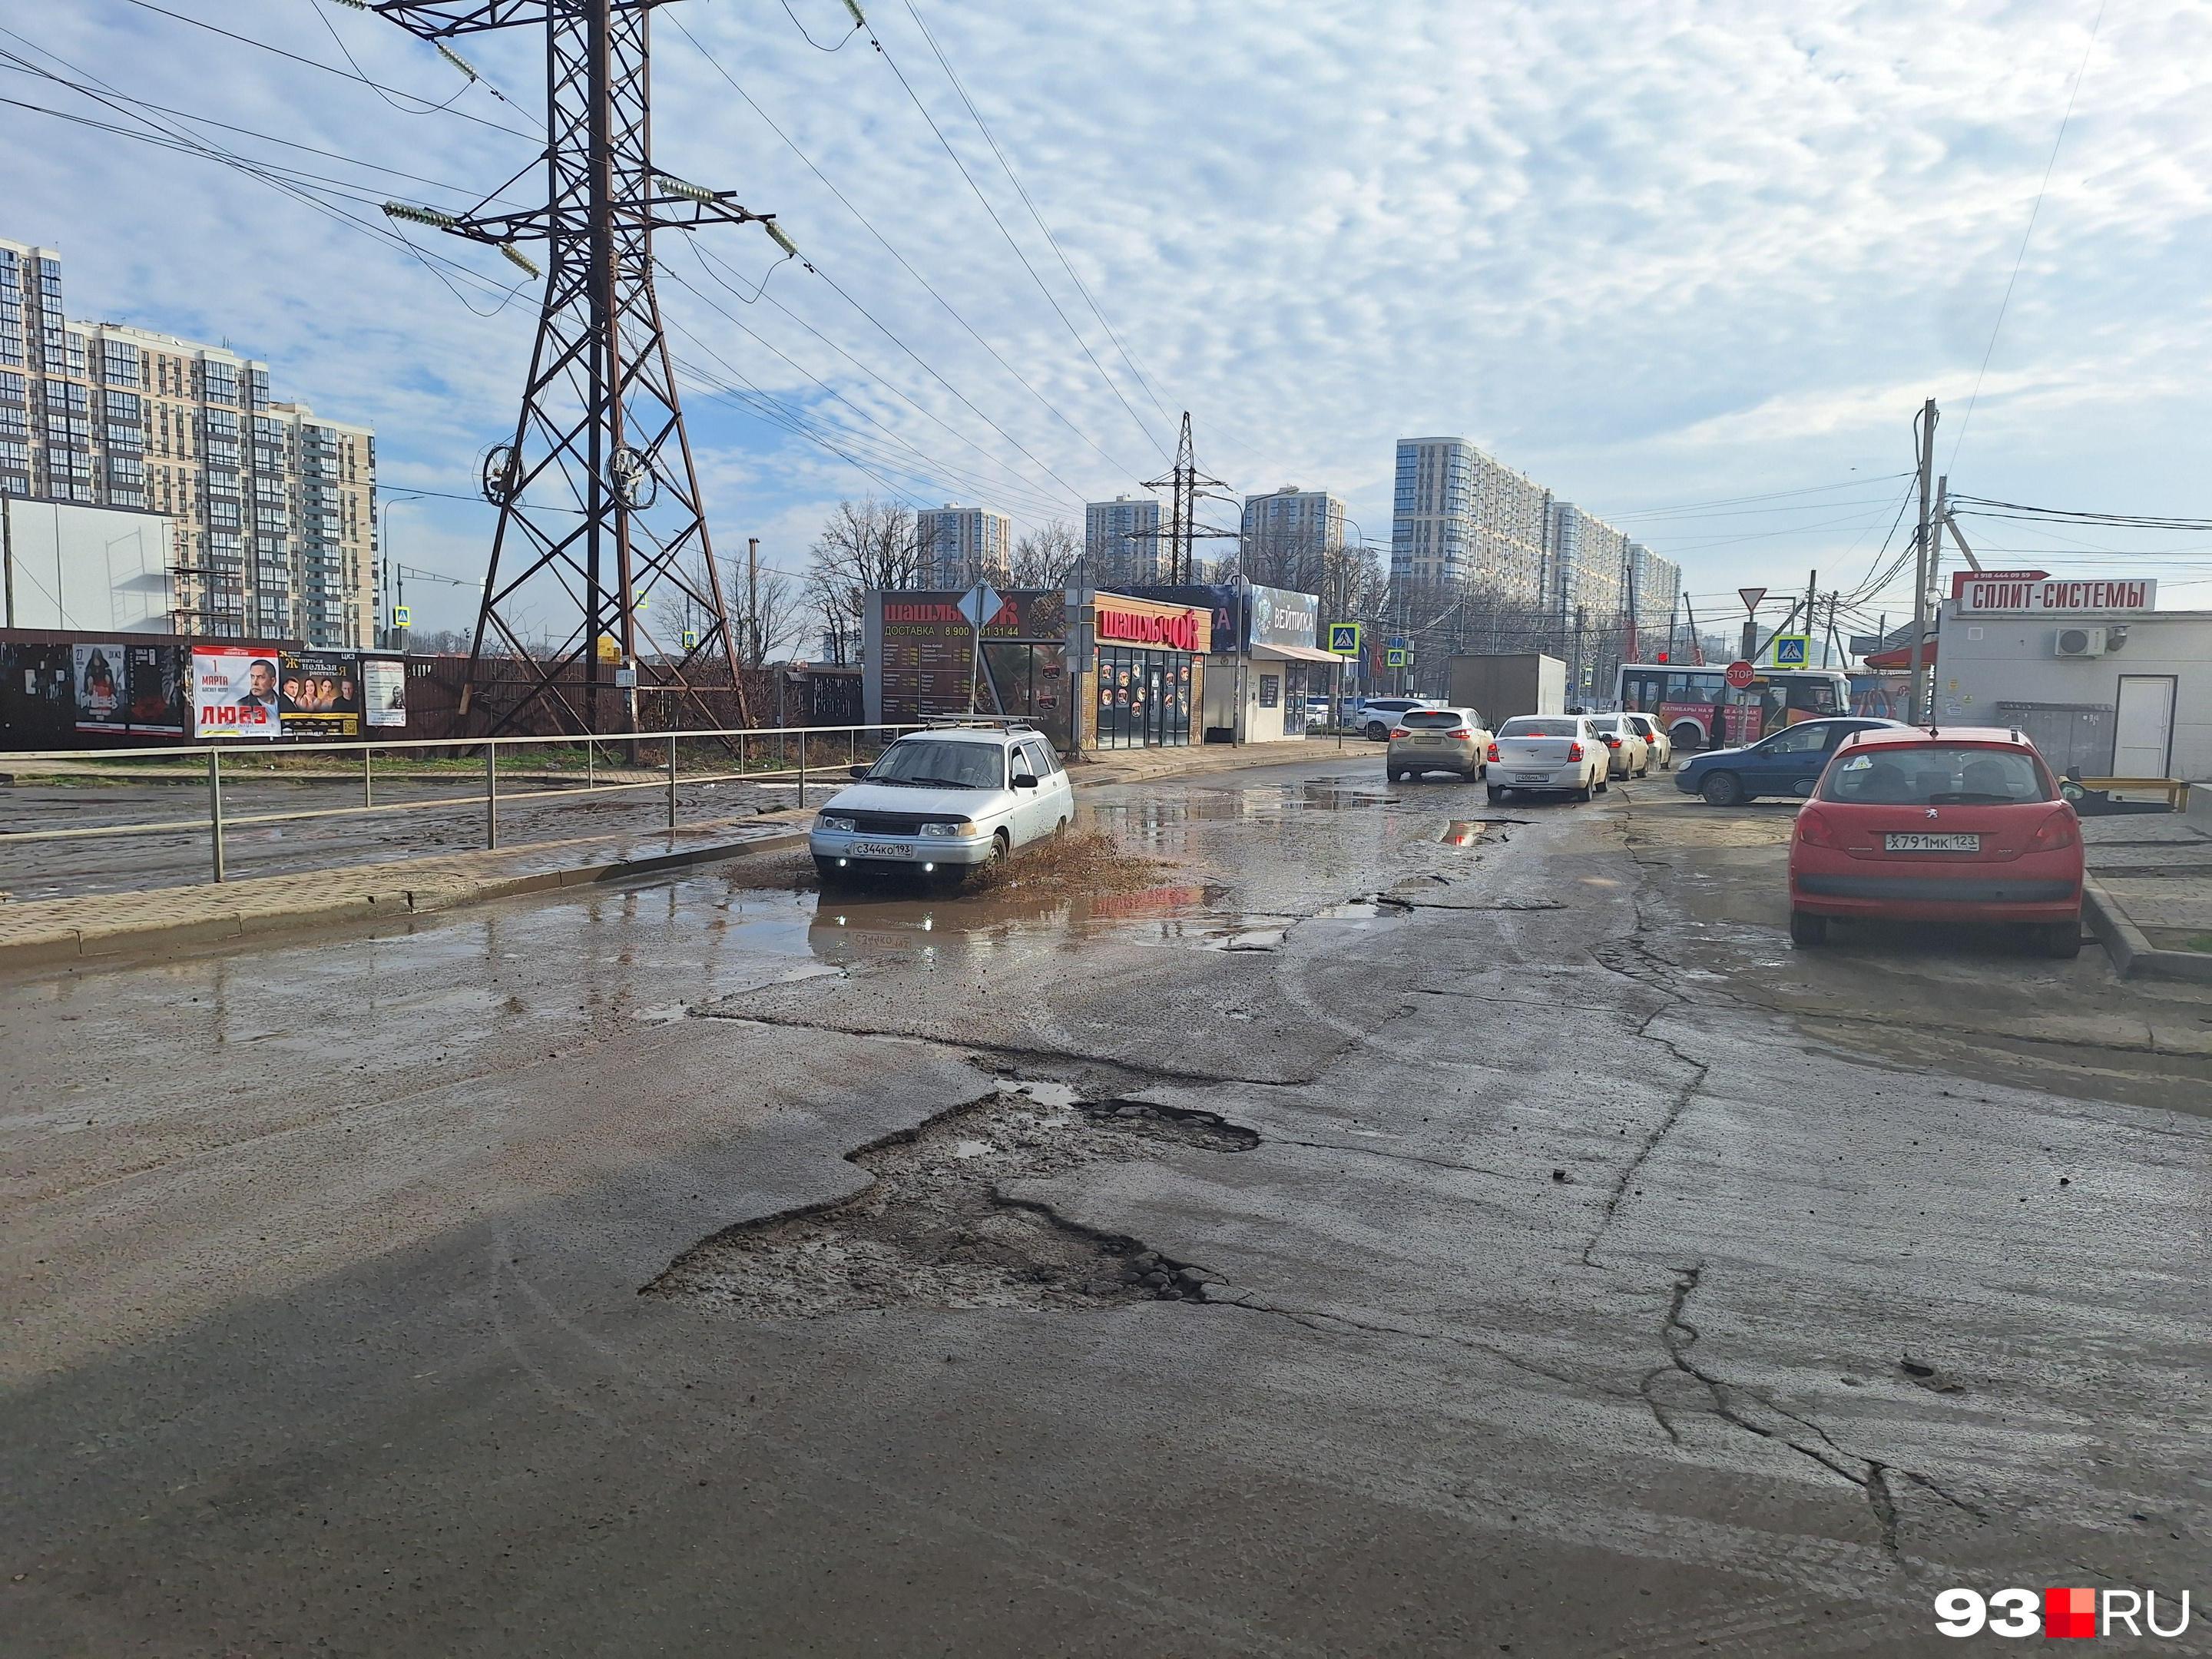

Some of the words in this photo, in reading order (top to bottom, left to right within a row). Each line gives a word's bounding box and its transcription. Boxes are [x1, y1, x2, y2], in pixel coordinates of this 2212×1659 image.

[1972, 582, 2146, 608] СПЛИТ-СИСТЕМЫ
[1274, 604, 1313, 632] ВЕЙПИКА
[885, 626, 935, 636] ДОСТАВКА
[945, 626, 951, 636] 8
[953, 626, 969, 636] 900
[993, 627, 1004, 636] 31
[1007, 627, 1019, 637] 44
[213, 659, 217, 673] 1
[1727, 669, 1753, 678] STOP
[202, 676, 228, 685] МАРТА
[200, 706, 267, 724] ЛЮБЭ
[856, 843, 894, 855] С344КО
[1890, 836, 1949, 849] Х791МК
[1953, 836, 1975, 846] 123
